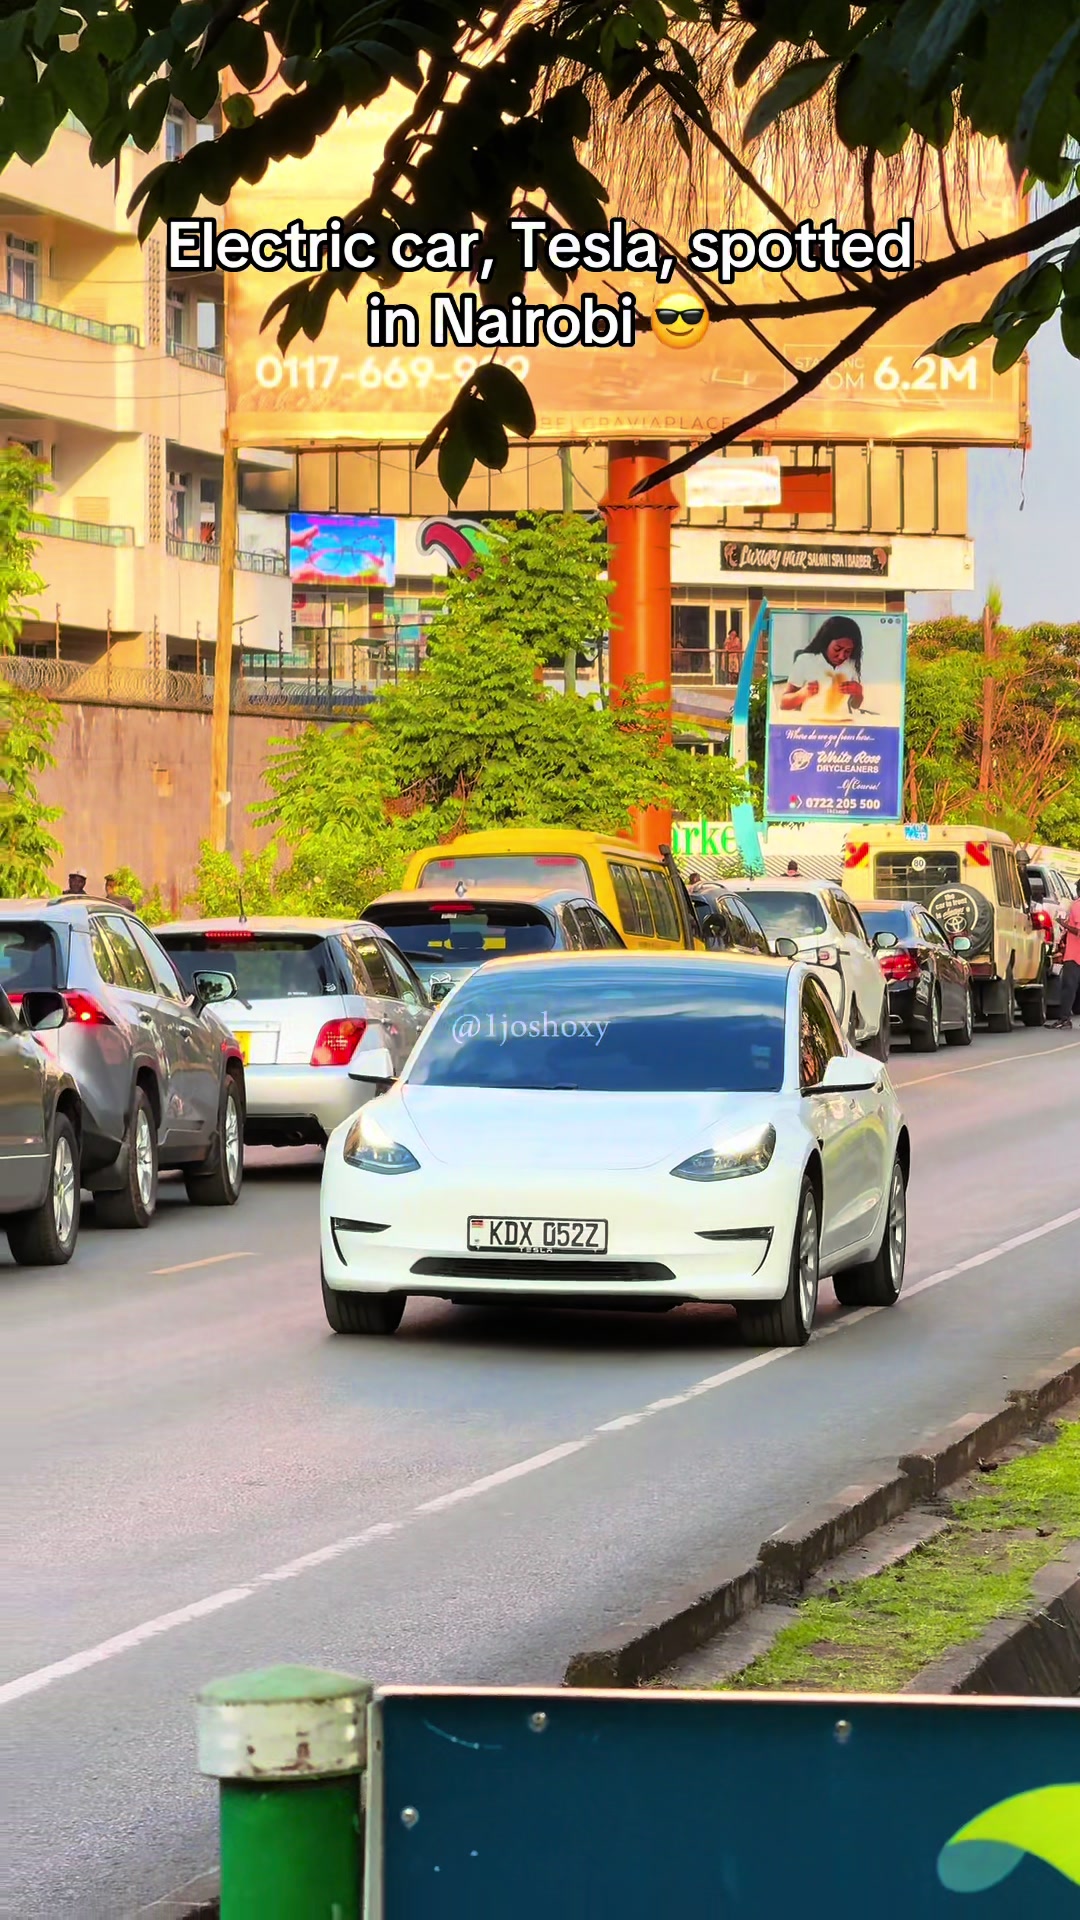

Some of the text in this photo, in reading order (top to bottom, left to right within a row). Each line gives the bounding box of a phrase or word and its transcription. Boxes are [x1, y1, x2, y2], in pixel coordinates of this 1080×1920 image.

[256, 354, 530, 390] 0117-669-99
[873, 355, 978, 391] 6.2M
[816, 750, 881, 764] White Rose
[817, 765, 879, 773] DRYCLEANERS
[805, 797, 881, 810] 0722 205 500
[489, 1220, 599, 1247] KDX 052Z
[518, 1246, 553, 1254] TESLA
